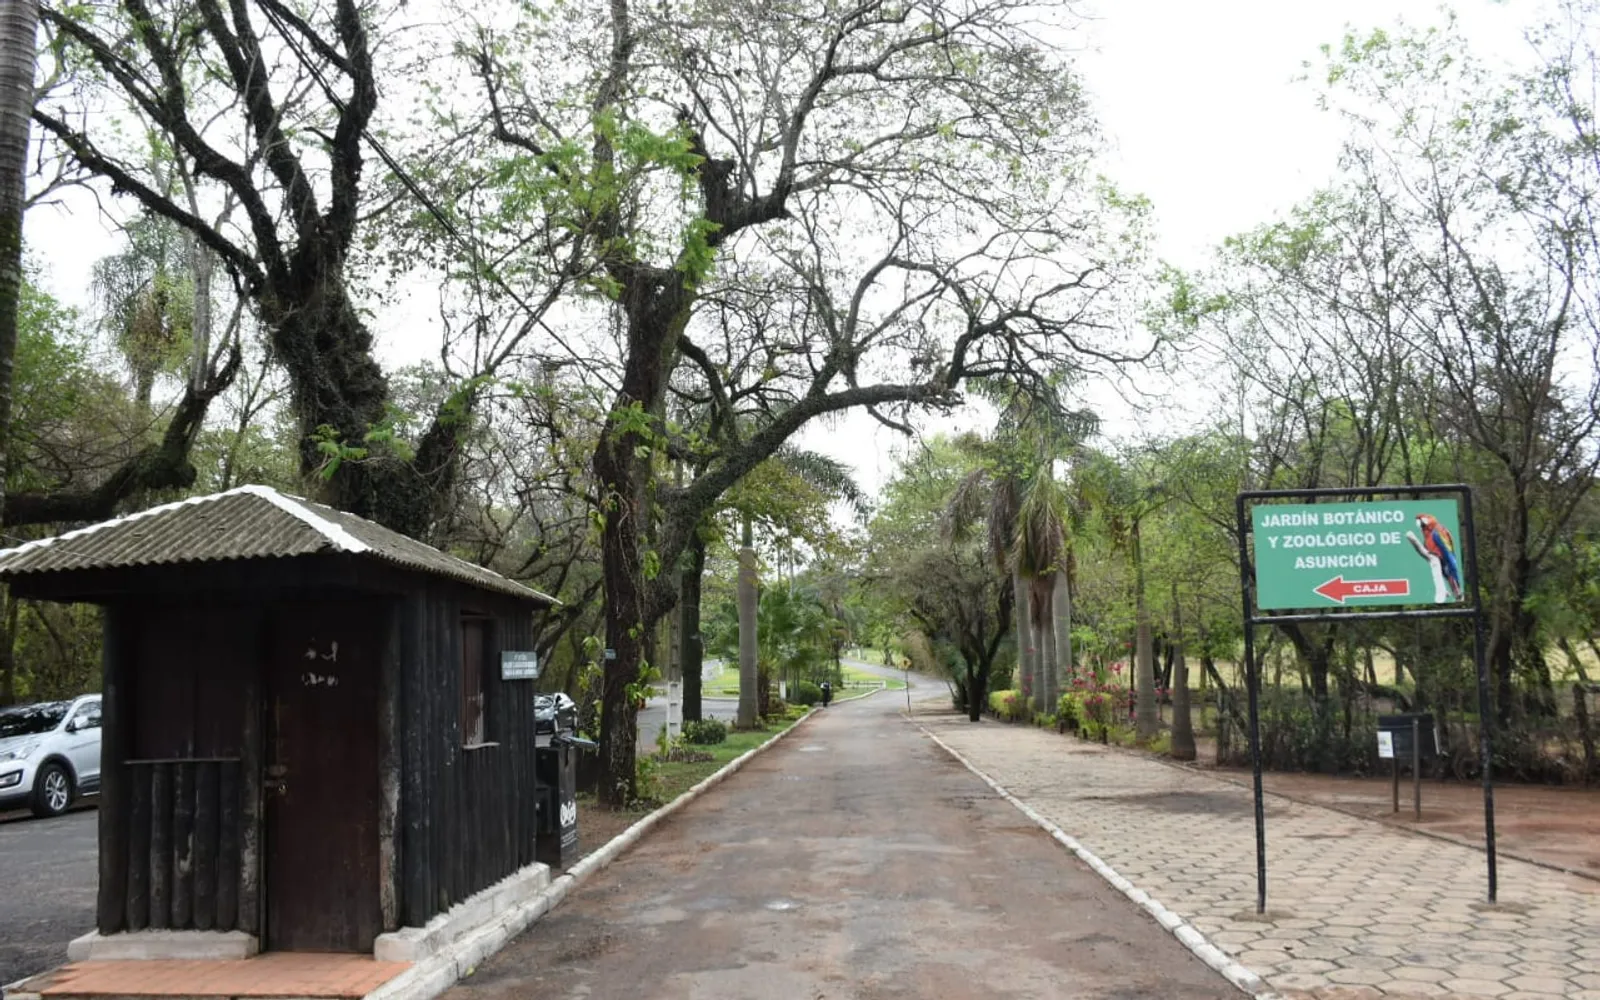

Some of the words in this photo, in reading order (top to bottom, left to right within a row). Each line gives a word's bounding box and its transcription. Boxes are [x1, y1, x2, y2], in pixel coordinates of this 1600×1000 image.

[1261, 511, 1318, 527] JARDÍN
[1324, 509, 1404, 525] BOTÁNICO
[1268, 536, 1279, 549] Y
[1283, 532, 1375, 548] ZOOLÓGICO
[1380, 532, 1401, 544] DE
[1295, 552, 1377, 569] ASUNCIÓN
[1353, 584, 1388, 593] CAJA
